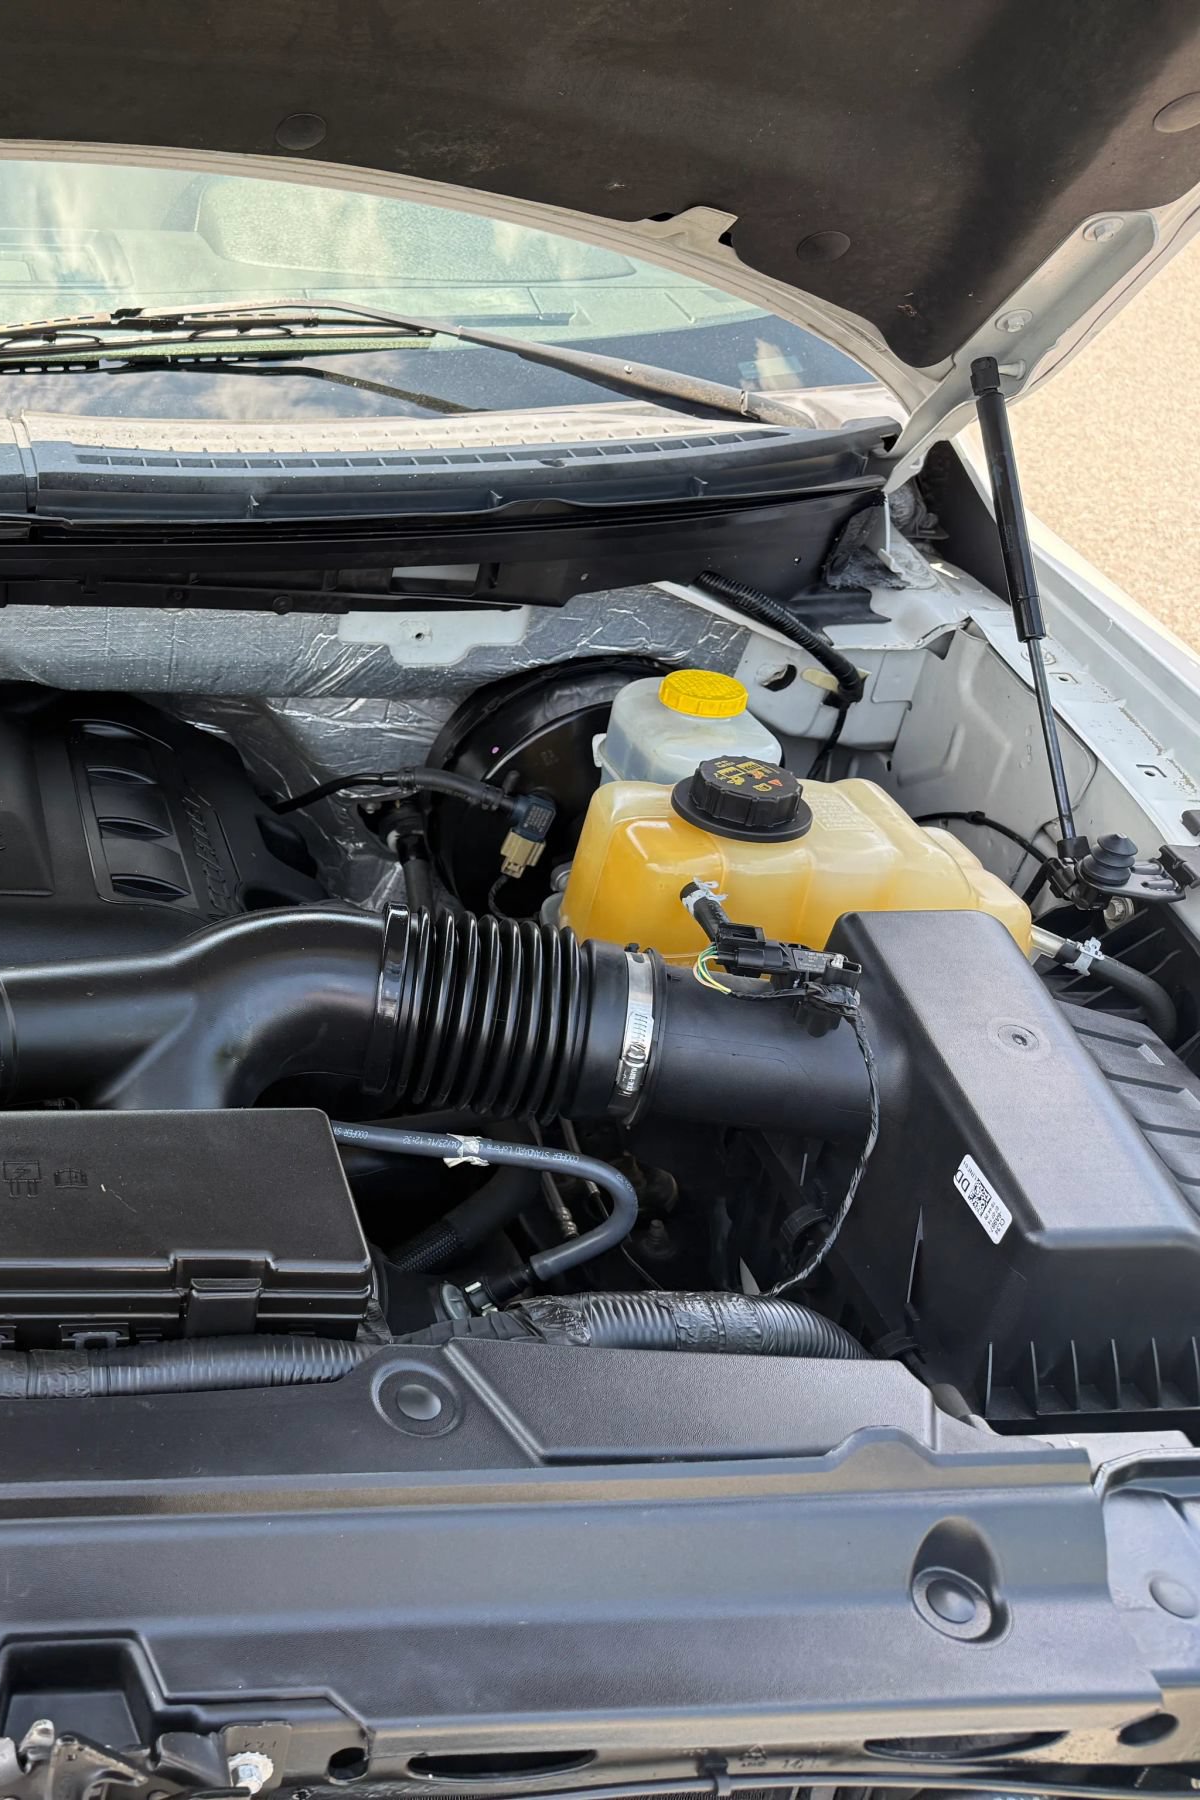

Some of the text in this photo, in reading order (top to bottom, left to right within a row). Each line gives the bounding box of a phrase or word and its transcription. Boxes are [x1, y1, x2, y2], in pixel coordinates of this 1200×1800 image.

[343, 1128, 369, 1140] COOPER
[402, 1135, 424, 1146] 12:32
[515, 1146, 550, 1160] STANDARD
[552, 1151, 580, 1164] COOPER
[955, 1169, 970, 1193] DD
